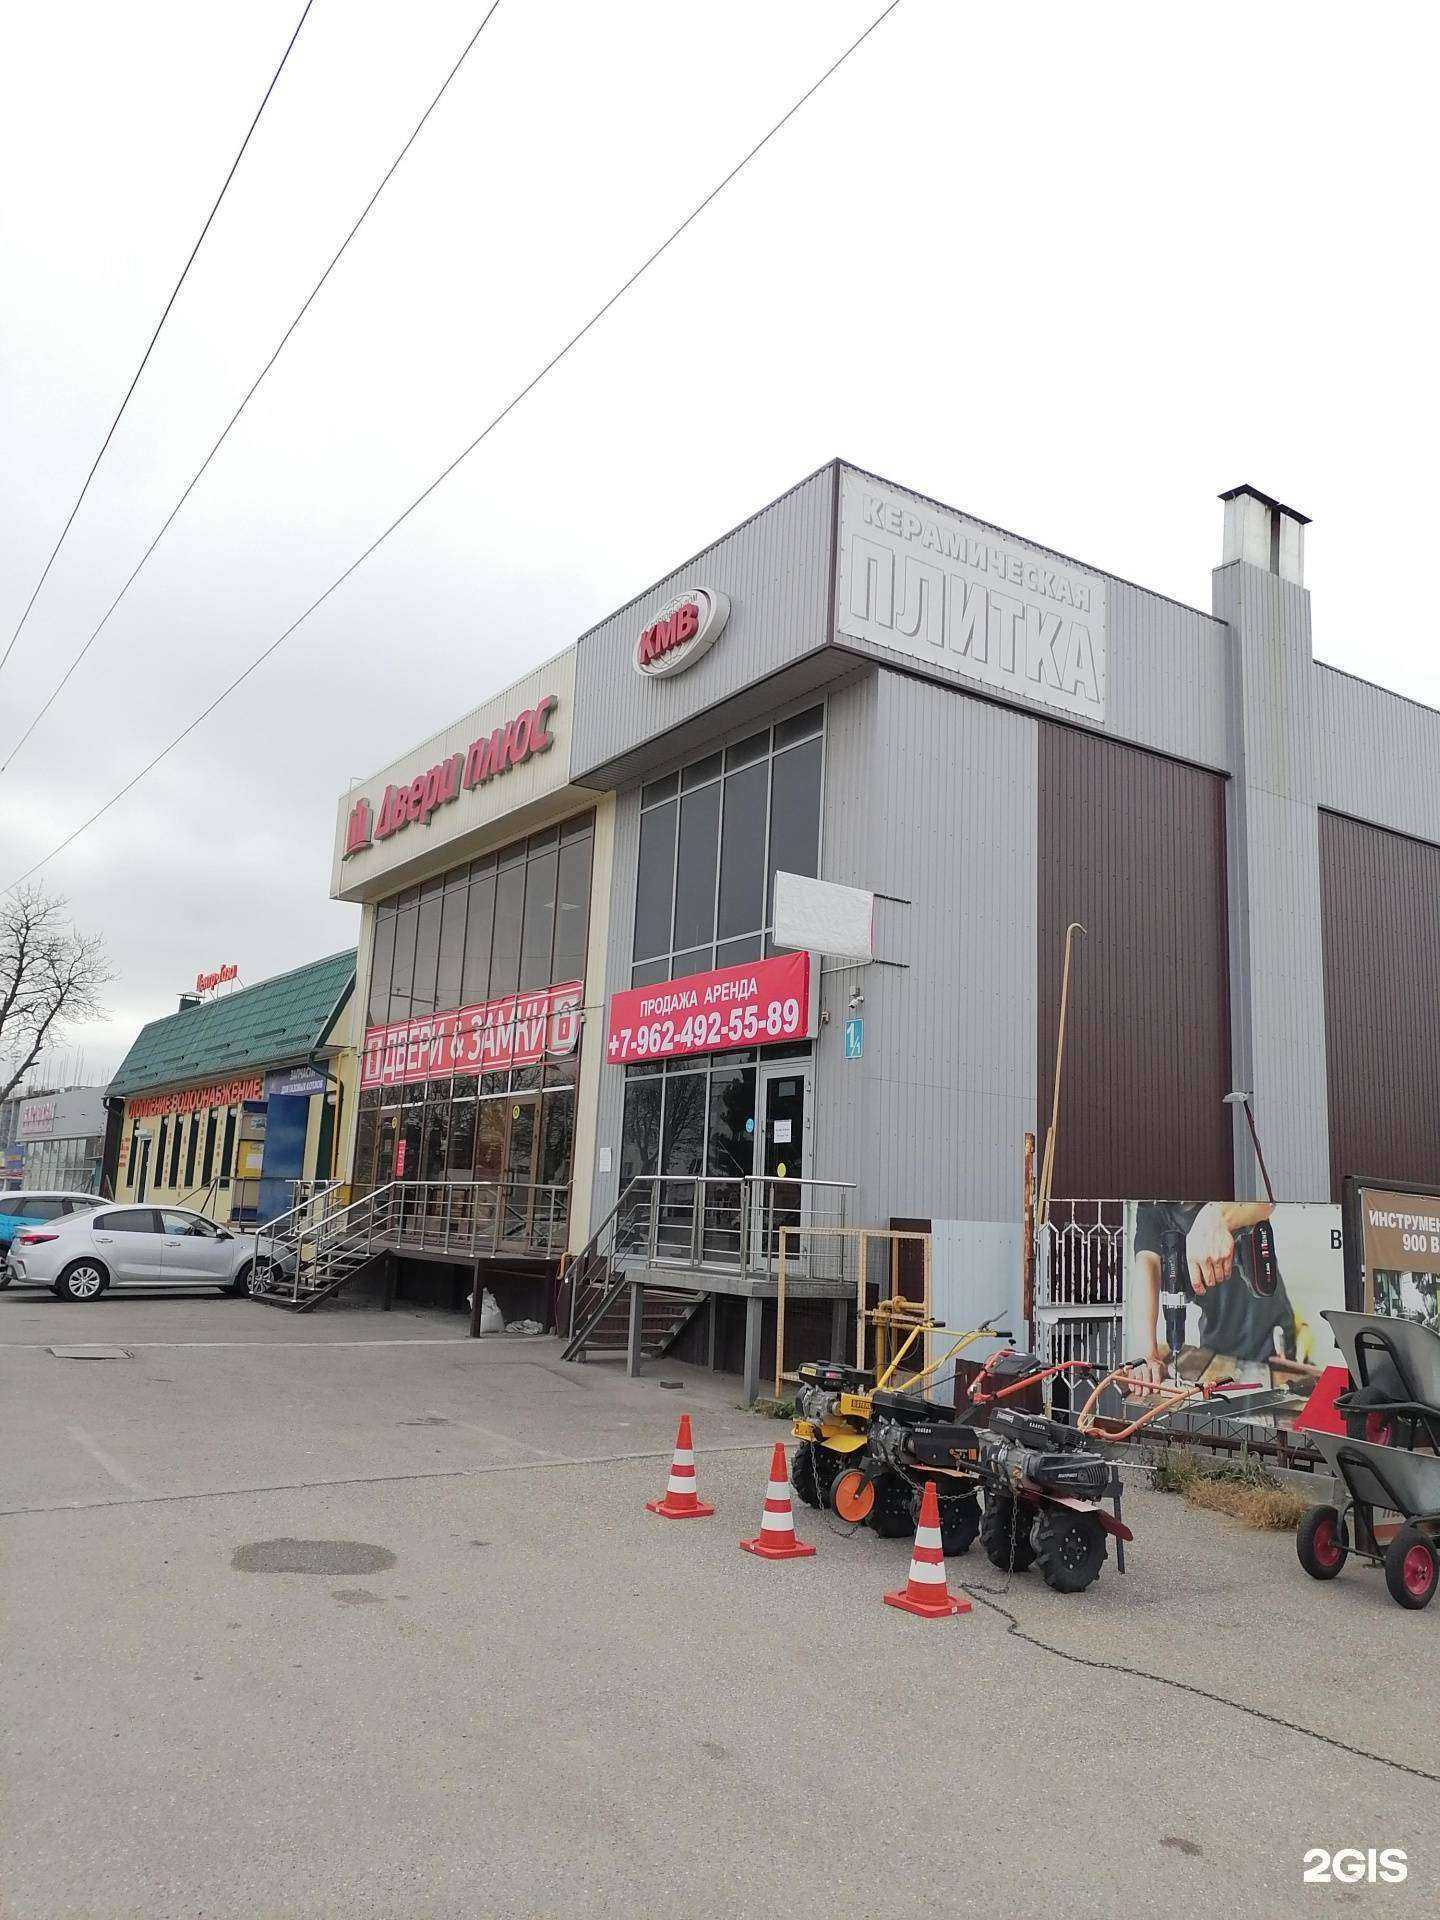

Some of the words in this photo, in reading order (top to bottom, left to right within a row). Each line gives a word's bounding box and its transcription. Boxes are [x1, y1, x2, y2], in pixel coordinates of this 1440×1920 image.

[862, 492, 1092, 614] КЕРАМИЧЕСКАЯ
[850, 534, 1101, 704] ПЛИТКА
[608, 997, 799, 1058] +7-962-492-55-89
[640, 991, 698, 1018] ПРОДАЖА
[704, 976, 759, 1005] АРЕНДА
[382, 1022, 446, 1081] ДВЕРИ
[450, 1020, 464, 1060] &
[468, 1000, 548, 1062] ЗАМКИ
[1403, 1233, 1427, 1253] 900
